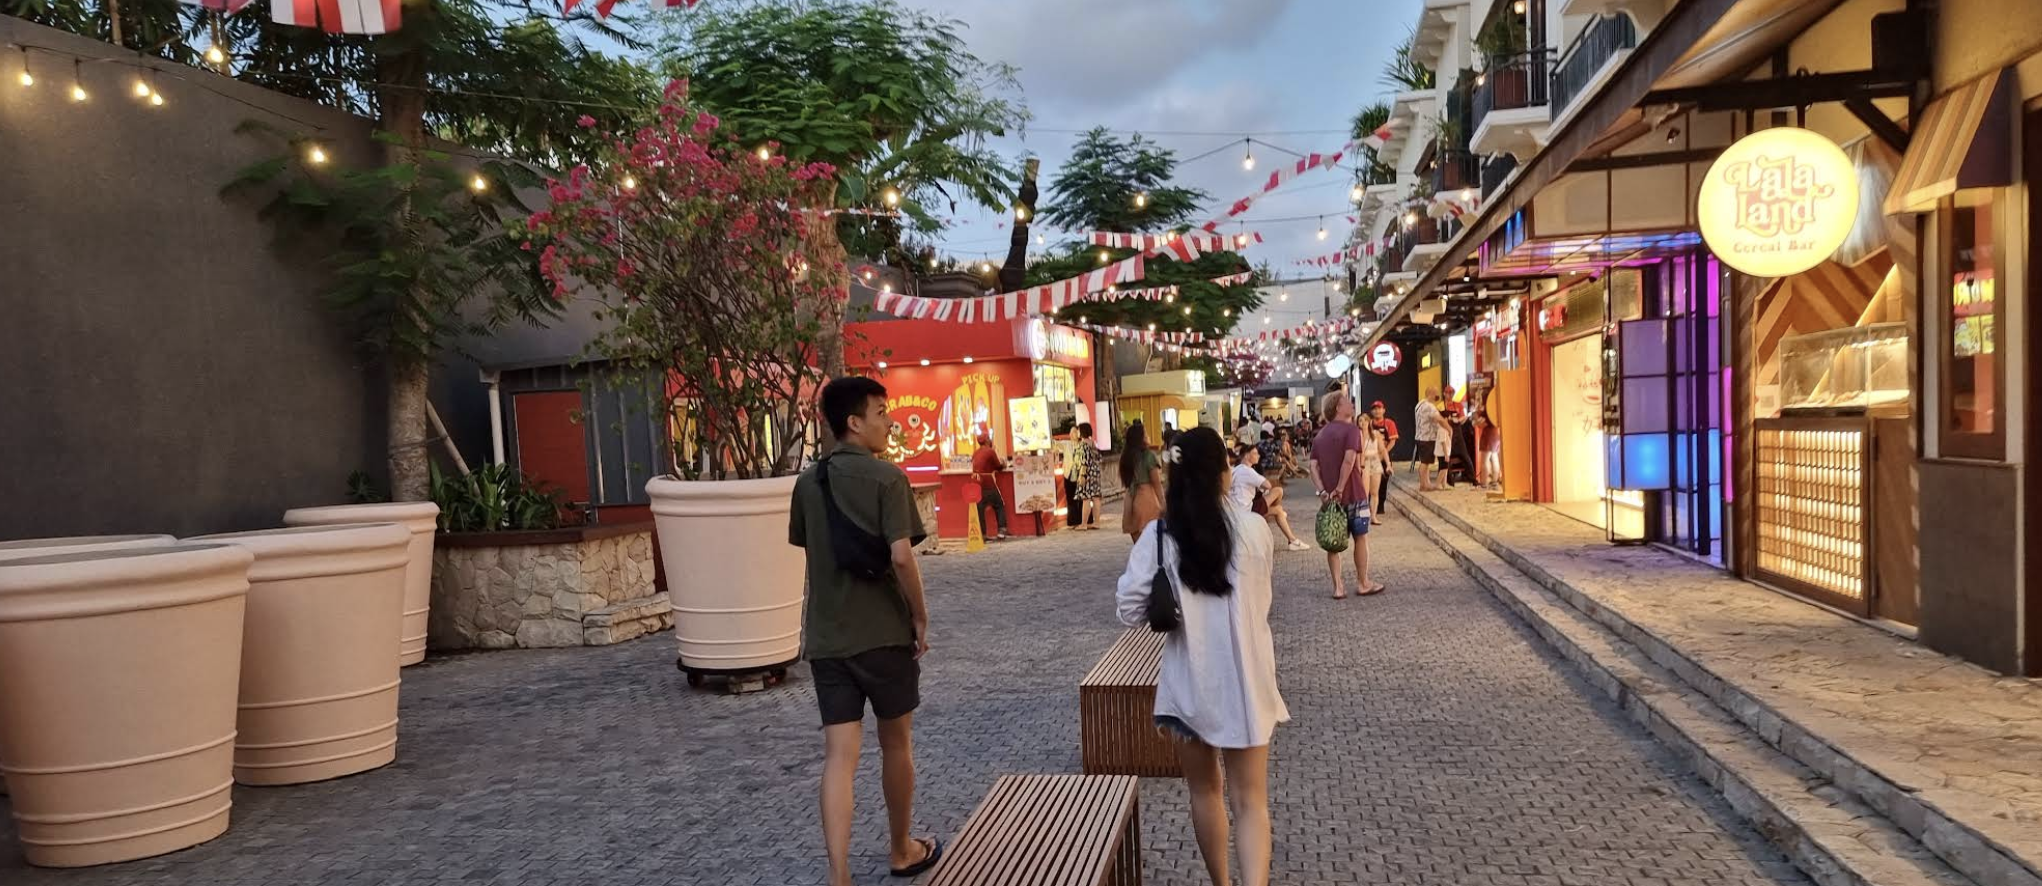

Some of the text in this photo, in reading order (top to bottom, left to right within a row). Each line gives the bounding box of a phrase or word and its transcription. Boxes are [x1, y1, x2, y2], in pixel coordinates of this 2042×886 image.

[1733, 240, 1814, 253] Cereal Bar
[962, 373, 1000, 384] PICK UP
[886, 395, 937, 413] RAB&CO
